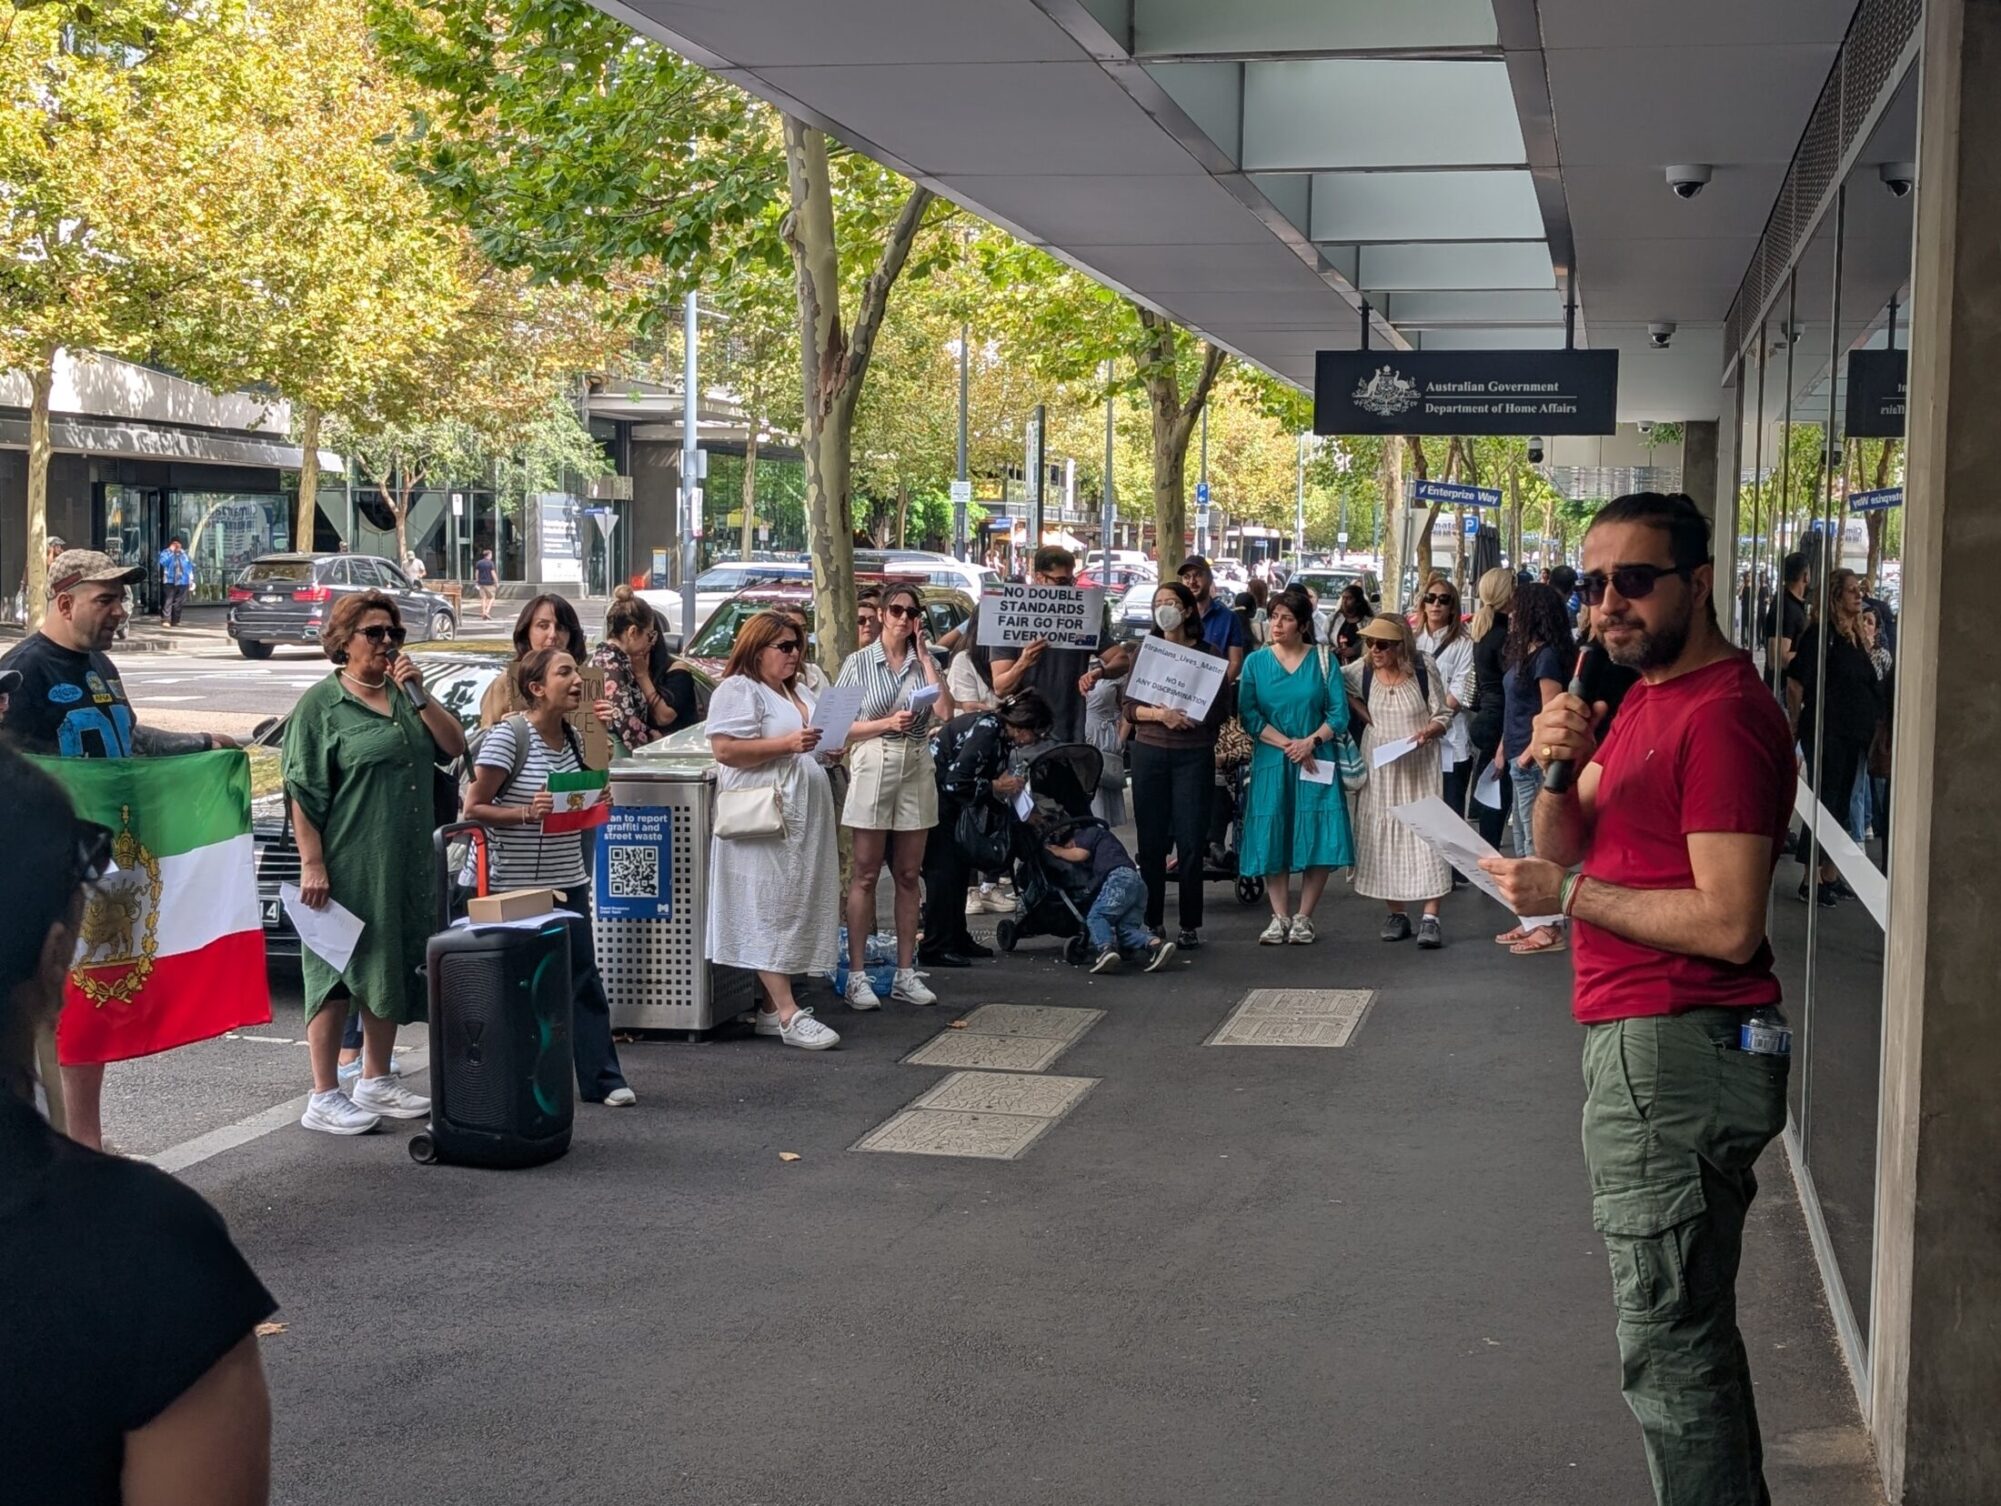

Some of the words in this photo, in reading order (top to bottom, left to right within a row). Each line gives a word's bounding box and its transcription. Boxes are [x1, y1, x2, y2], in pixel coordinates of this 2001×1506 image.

[1425, 381, 1485, 392] Australian
[1488, 381, 1559, 392] Government
[1425, 403, 1489, 416] Department
[1491, 403, 1503, 413] of
[1505, 403, 1537, 413] Home
[1539, 403, 1577, 413] Affairs
[1427, 485, 1475, 500] Enterprize
[1477, 491, 1499, 505] Way
[1465, 519, 1474, 532] P
[1004, 587, 1024, 598] NO
[1028, 588, 1083, 601] DOUBLE
[1000, 600, 1085, 615] STANDARDS
[998, 616, 1029, 627] FAIR
[1033, 617, 1052, 629] GO
[1056, 618, 1083, 630] FOR
[1003, 630, 1076, 643] EVERYONE
[1165, 676, 1177, 685] NO
[1135, 677, 1151, 687] ANY
[1151, 682, 1207, 706] DISCRIMINATION
[624, 814, 635, 822] to
[637, 815, 668, 824] report
[606, 823, 640, 832] graffiti
[641, 823, 660, 832] and
